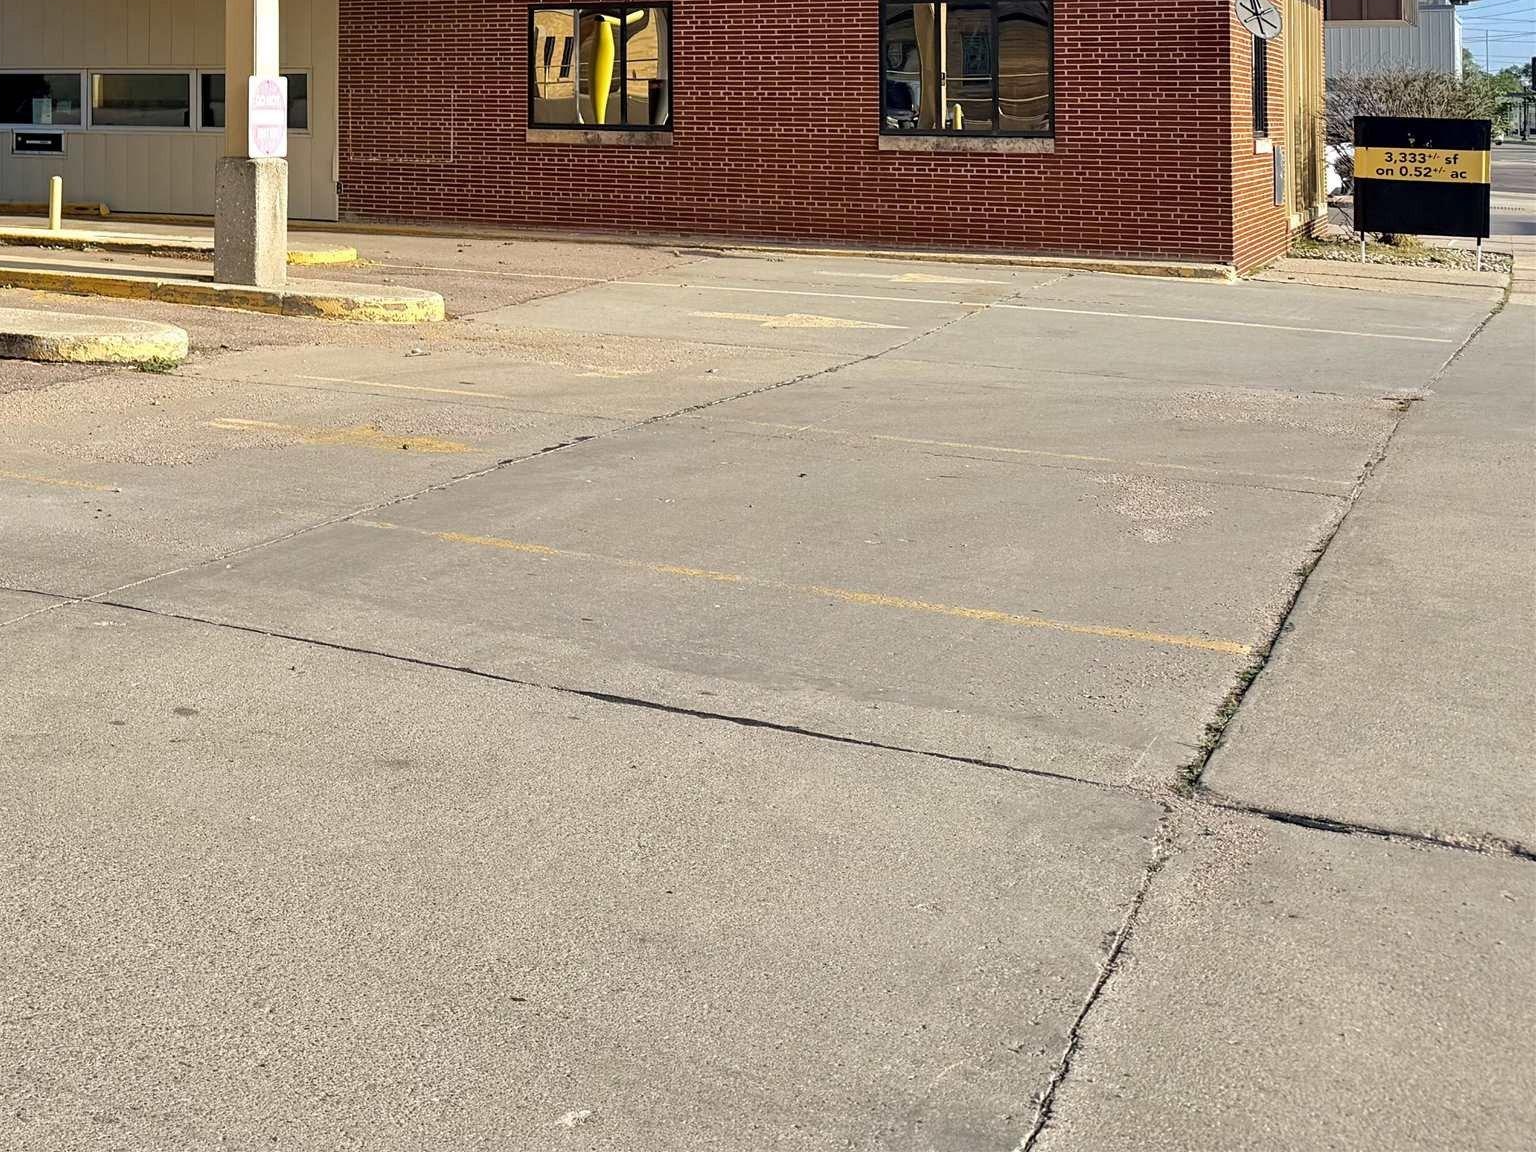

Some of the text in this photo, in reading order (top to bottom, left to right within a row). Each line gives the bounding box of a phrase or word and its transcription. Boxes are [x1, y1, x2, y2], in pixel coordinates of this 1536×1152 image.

[1445, 154, 1459, 165] sf
[1376, 167, 1394, 176] on
[1450, 170, 1468, 179] ac
